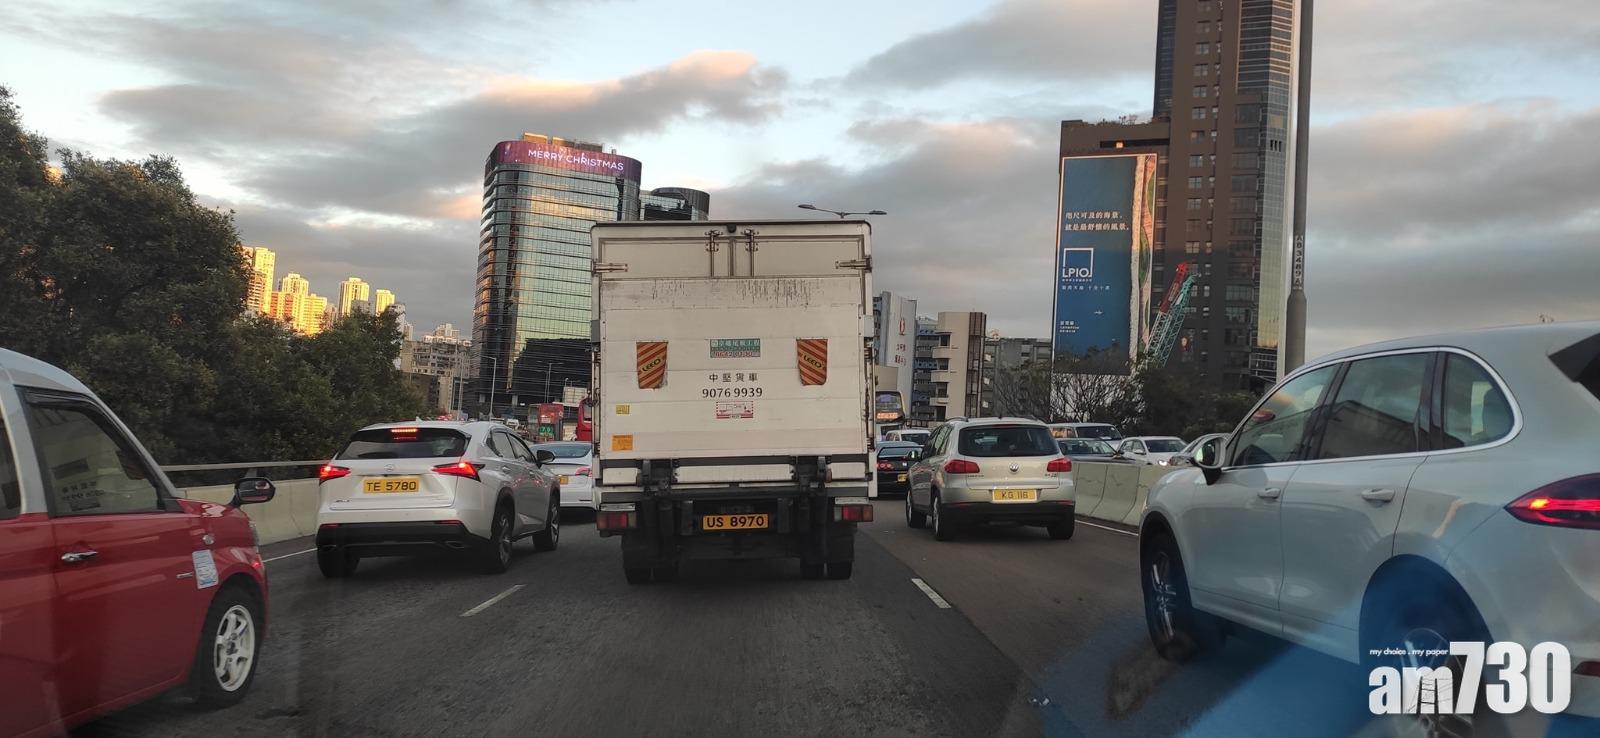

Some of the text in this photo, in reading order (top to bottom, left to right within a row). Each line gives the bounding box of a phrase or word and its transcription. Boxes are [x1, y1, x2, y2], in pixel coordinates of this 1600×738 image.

[528, 149, 624, 171] MERRY CHRISTMAS
[709, 372, 758, 383] 中堅貨車
[702, 387, 763, 398] 9076 9939
[367, 481, 417, 492] TE 5780
[1001, 491, 1014, 499] KG
[706, 516, 765, 528] US 8970
